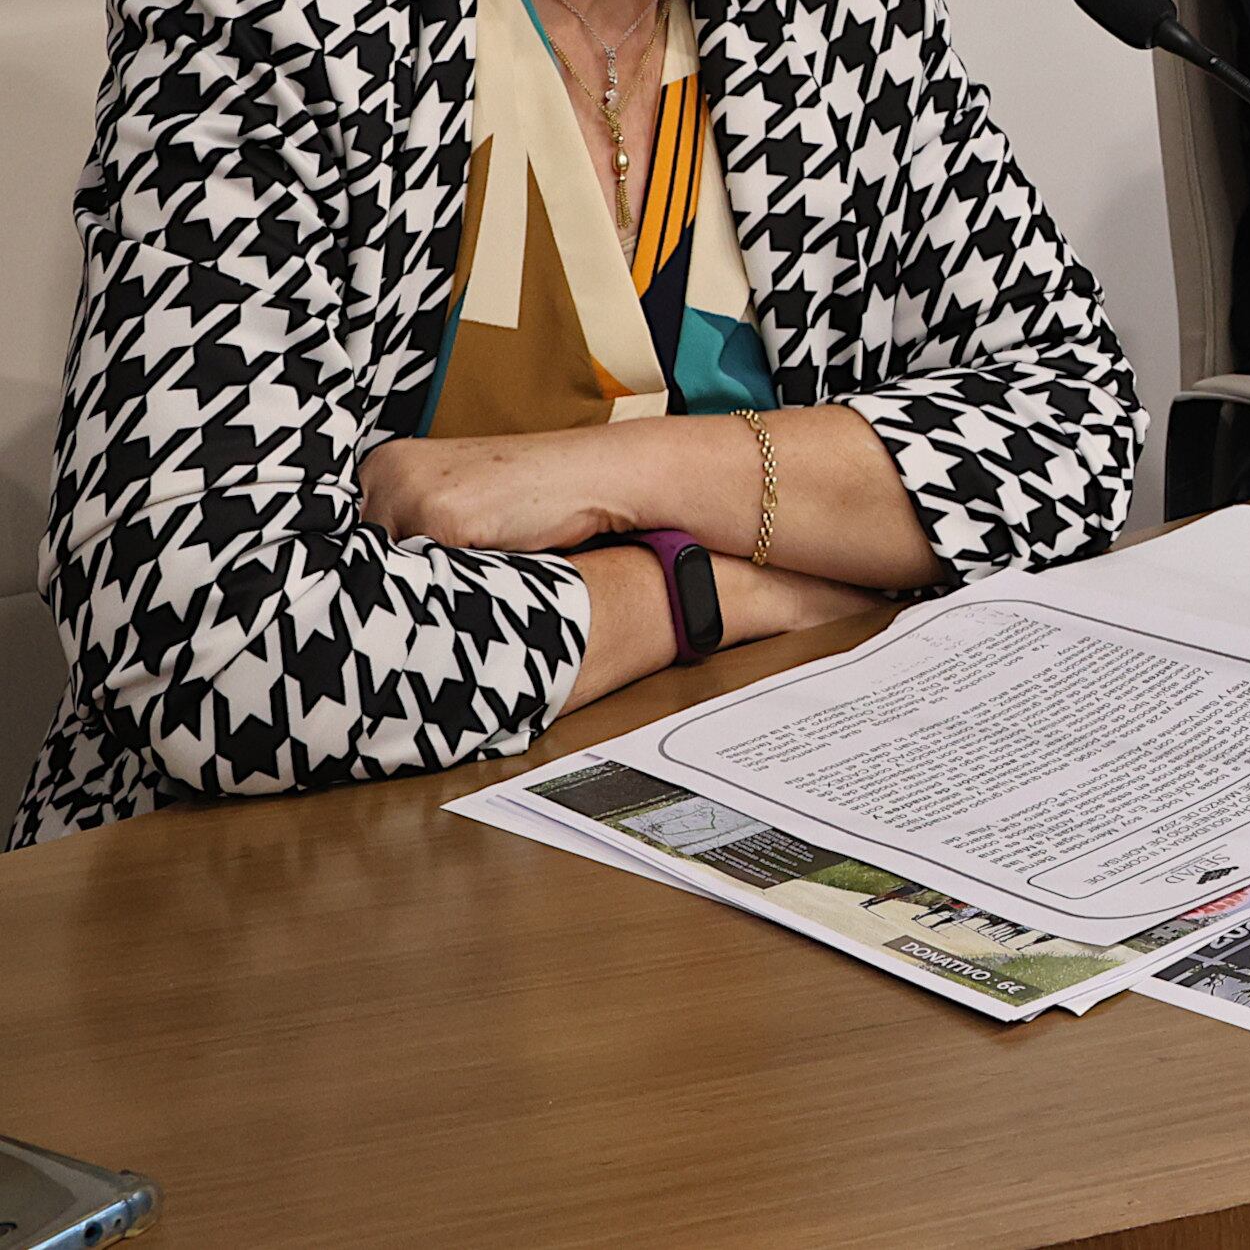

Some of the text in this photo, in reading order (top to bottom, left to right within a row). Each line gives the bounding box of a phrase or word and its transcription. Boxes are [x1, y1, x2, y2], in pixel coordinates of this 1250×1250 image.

[1142, 661, 1178, 683] padres
[953, 758, 1017, 787] asociación
[1197, 773, 1229, 789] todas
[1203, 767, 1218, 776] de
[1149, 770, 1194, 793] diputado
[884, 795, 931, 814] madres
[1105, 793, 1150, 813] Ricardo
[1127, 805, 1147, 813] En
[1198, 790, 1241, 812] MARZO
[1054, 813, 1106, 836] Cabezas
[1088, 814, 1123, 832] primer
[1121, 816, 1142, 826] soy
[1166, 807, 1229, 837] BENEFICIO
[1178, 811, 1199, 821] DE
[1151, 820, 1181, 834] 2024
[1168, 817, 1231, 846] SOLIDARIA
[1052, 833, 1084, 847] lugar
[1059, 828, 1118, 853] Mercedes
[1146, 836, 1167, 846] DE
[989, 844, 1036, 864] Manuel
[1027, 849, 1047, 858] dar
[1098, 845, 1146, 867] ADIFISA
[1001, 859, 1023, 868] las
[1014, 855, 1056, 873] Bernal
[1103, 855, 1149, 876] CORTE
[1165, 852, 1231, 884] SEPAD
[1083, 874, 1106, 885] DE
[900, 942, 992, 981] DONATIVO
[996, 980, 1027, 995] 6€
